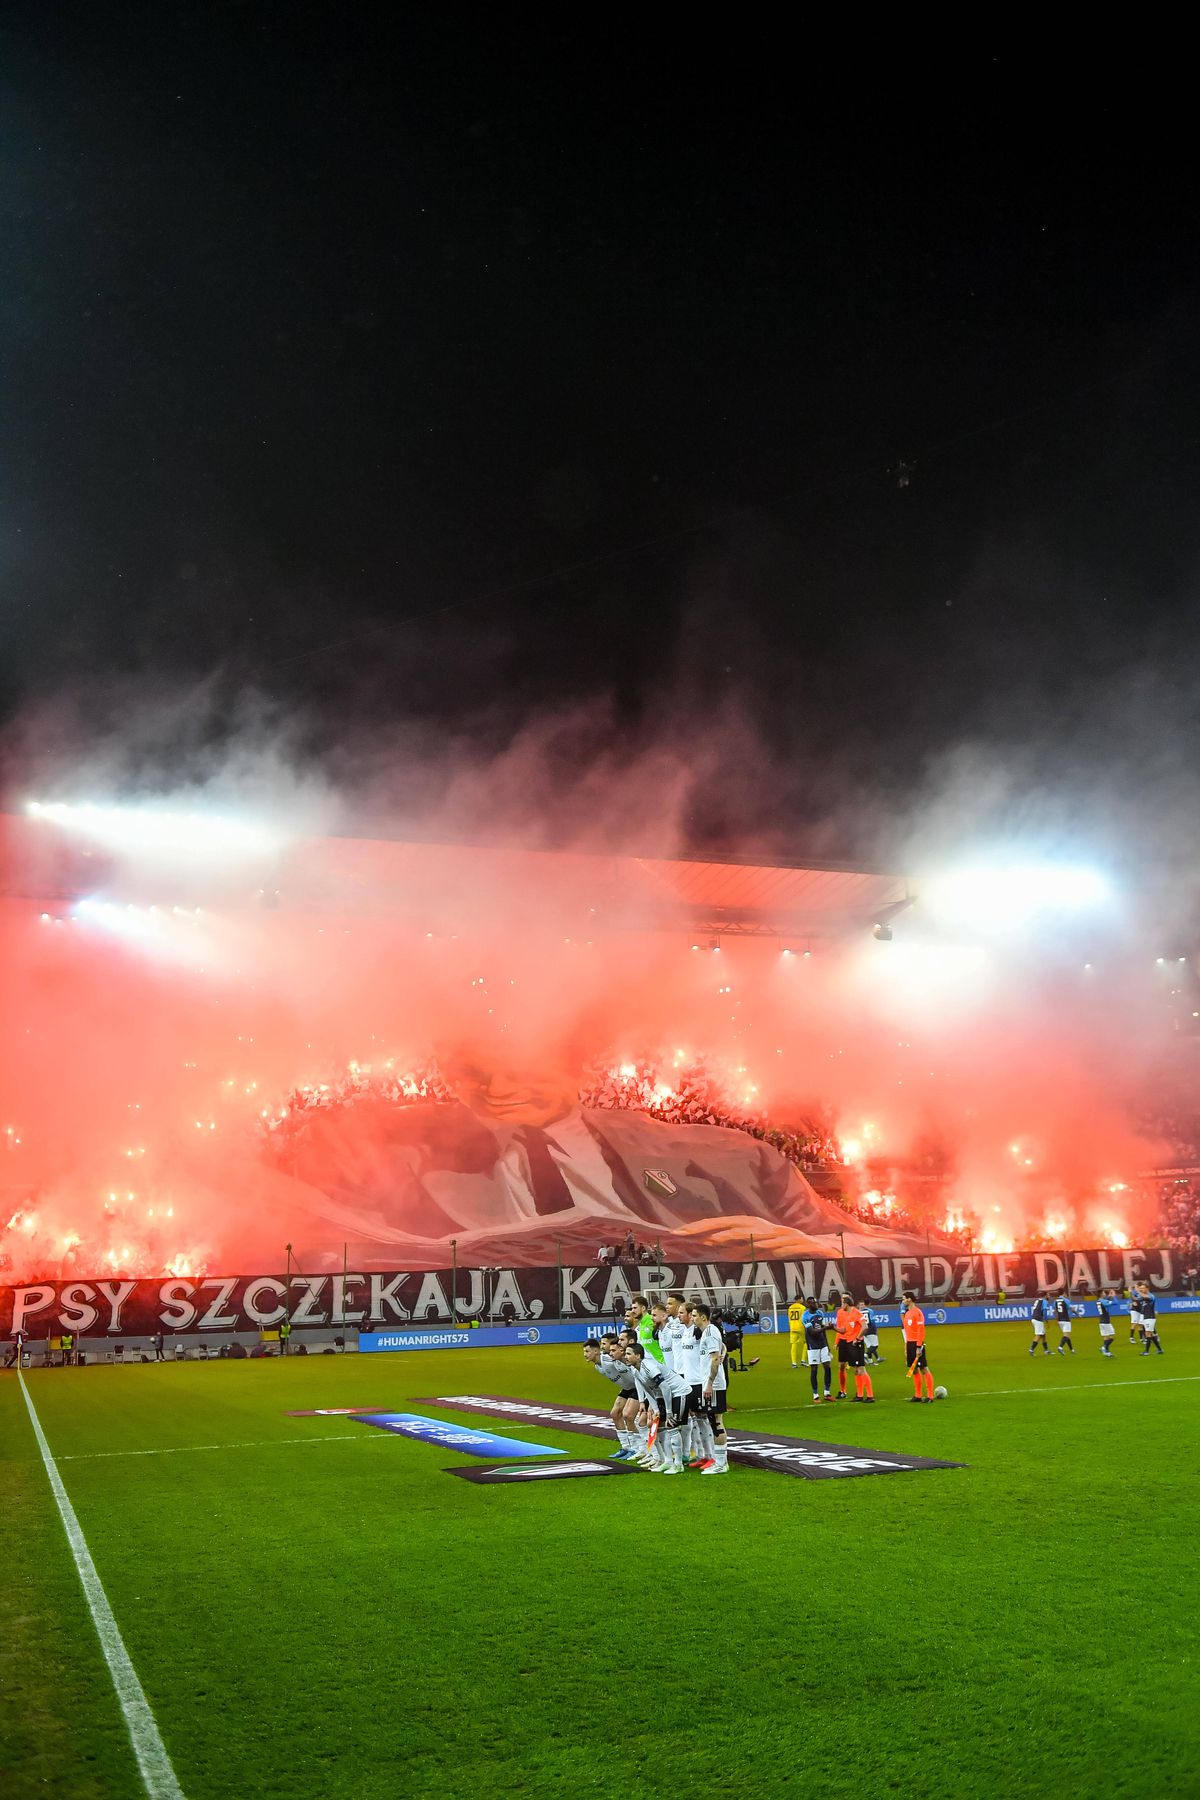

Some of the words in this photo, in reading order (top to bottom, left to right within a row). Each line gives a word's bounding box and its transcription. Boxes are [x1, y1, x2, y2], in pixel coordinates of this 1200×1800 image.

[11, 1282, 137, 1335] PSY
[560, 1260, 848, 1314] KARAWANA
[866, 1254, 1025, 1300] JEDZIE
[1034, 1249, 1173, 1292] DALEJ
[791, 1310, 799, 1320] 20
[984, 1306, 1028, 1319] HUMAN
[377, 1333, 469, 1347] #HUMANRIGHTS75
